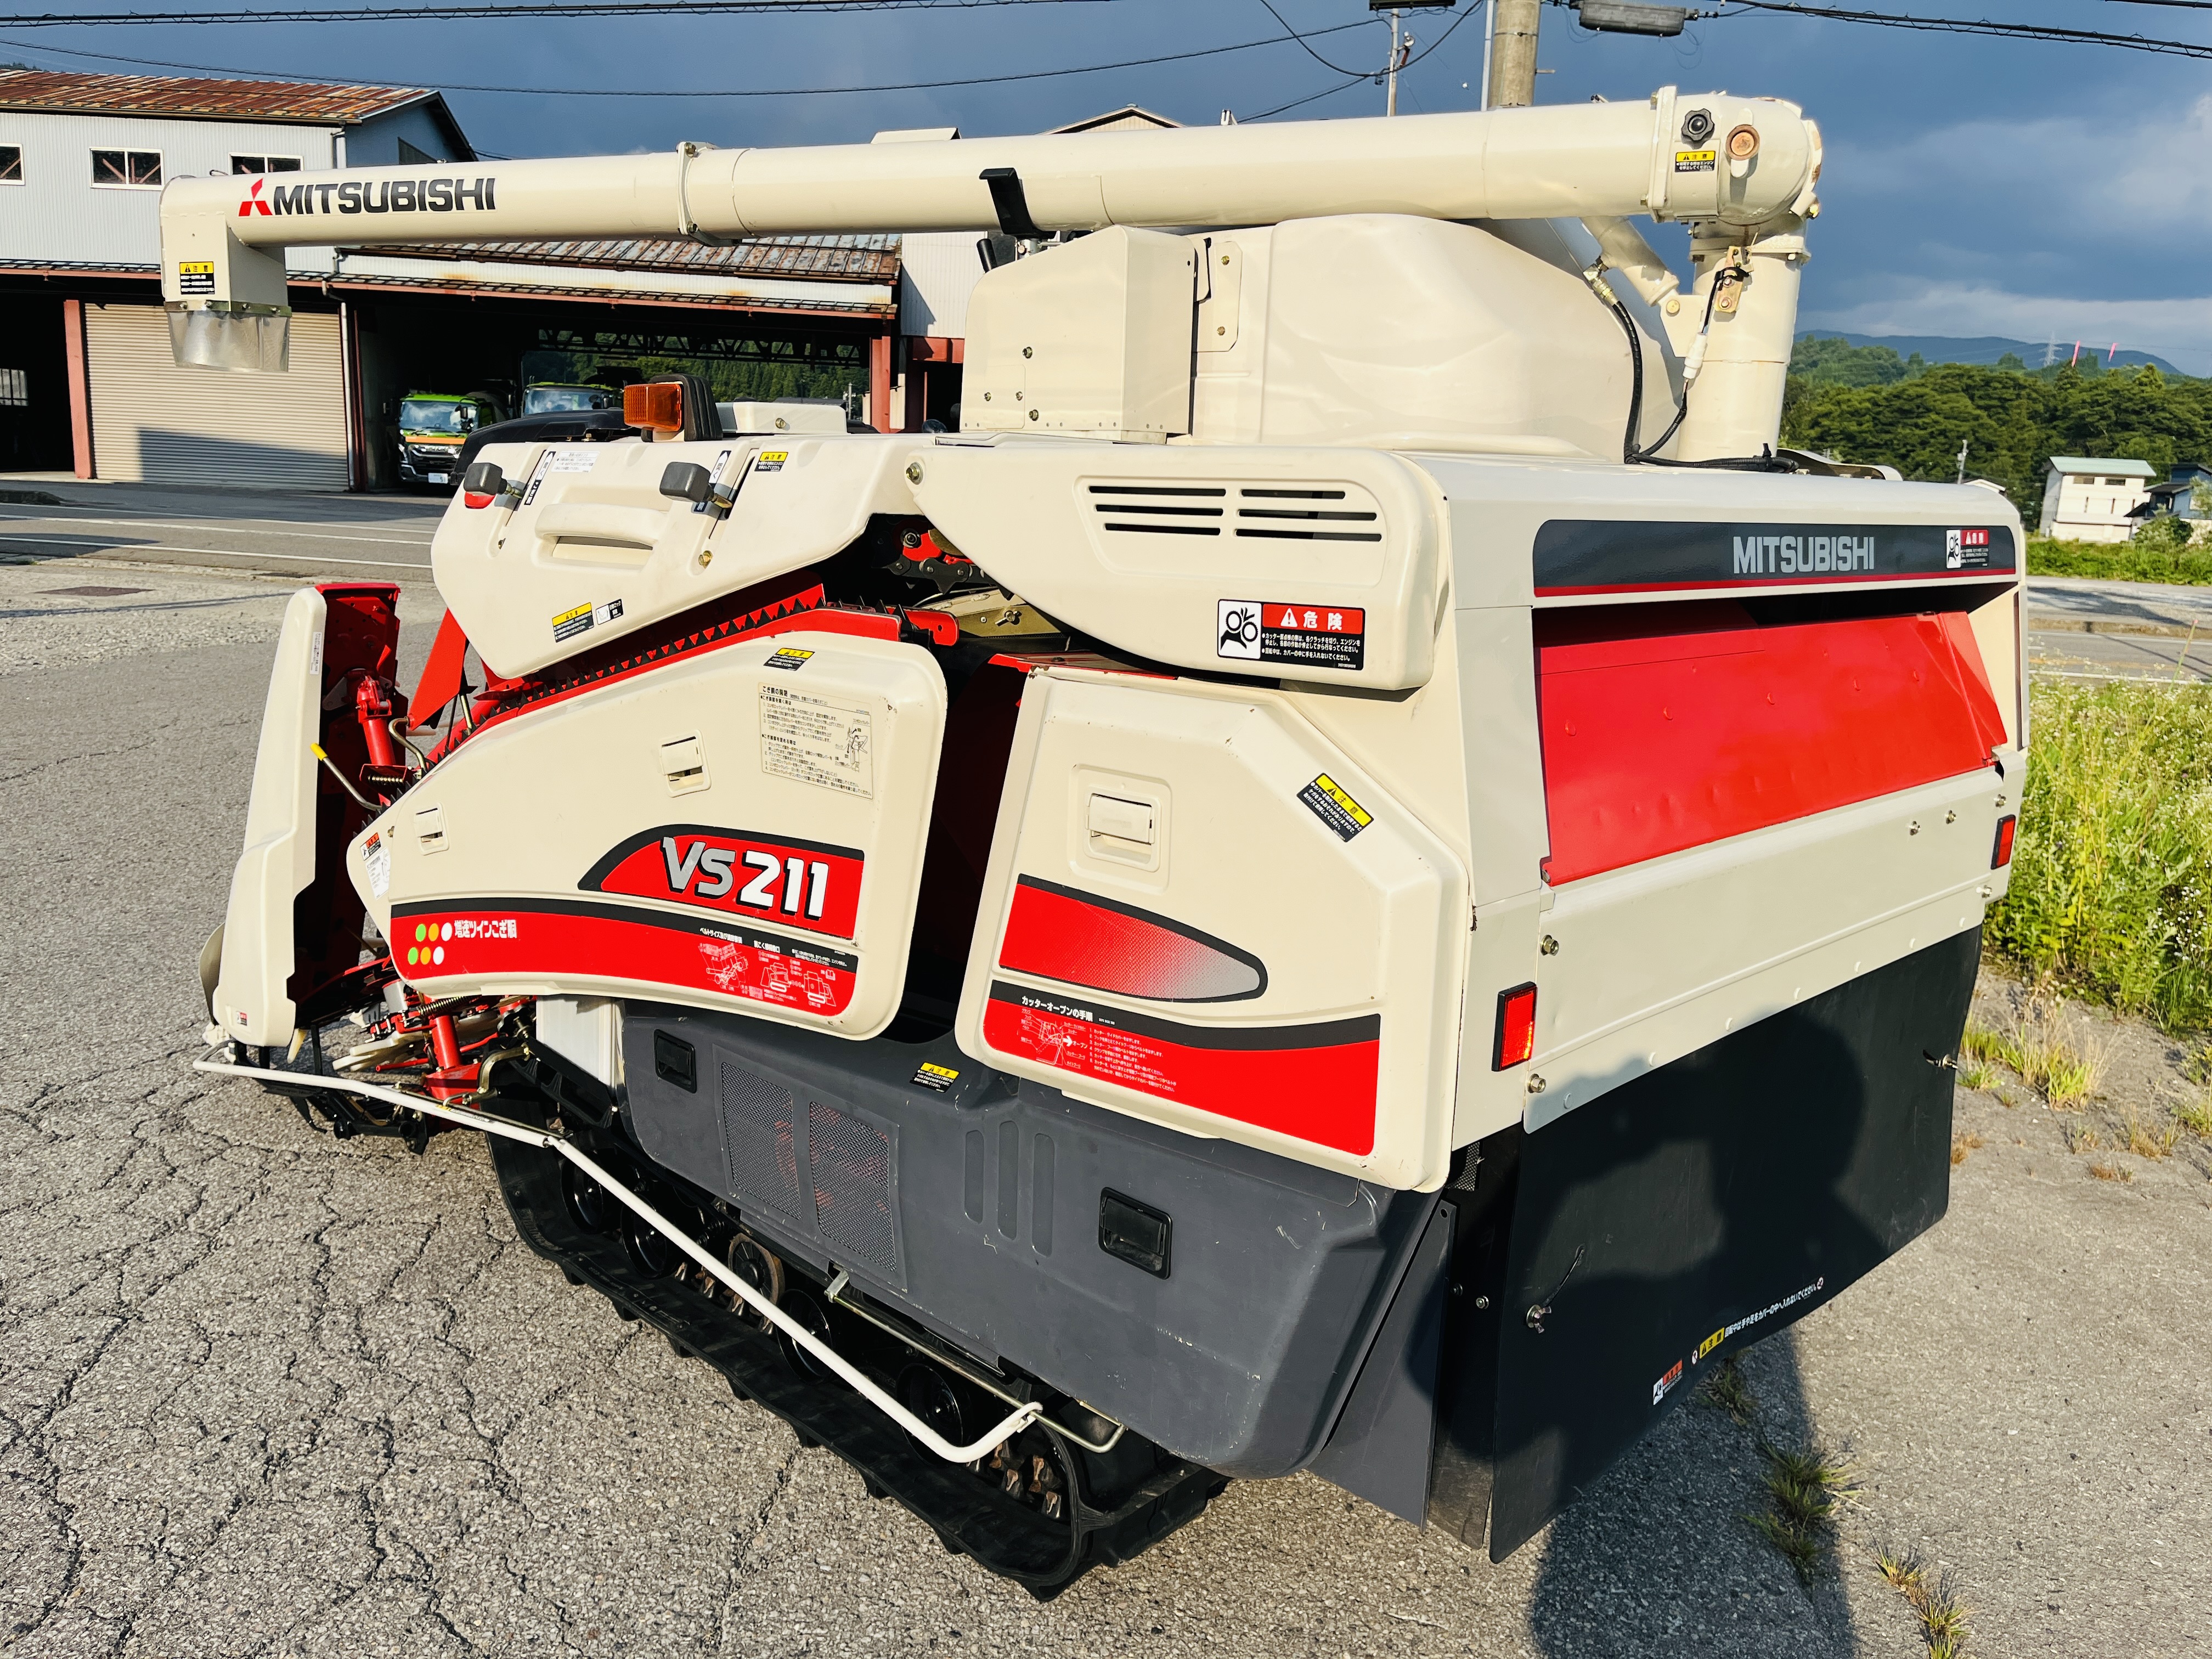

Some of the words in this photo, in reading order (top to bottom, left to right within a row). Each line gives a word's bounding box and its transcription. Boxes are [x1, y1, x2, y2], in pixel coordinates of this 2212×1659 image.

[274, 178, 495, 215] MITSUBISHI
[1733, 536, 1874, 574] MITSUBISHI
[1304, 611, 1342, 630] 危険
[1022, 996, 1093, 1022] カッターオープンの手順
